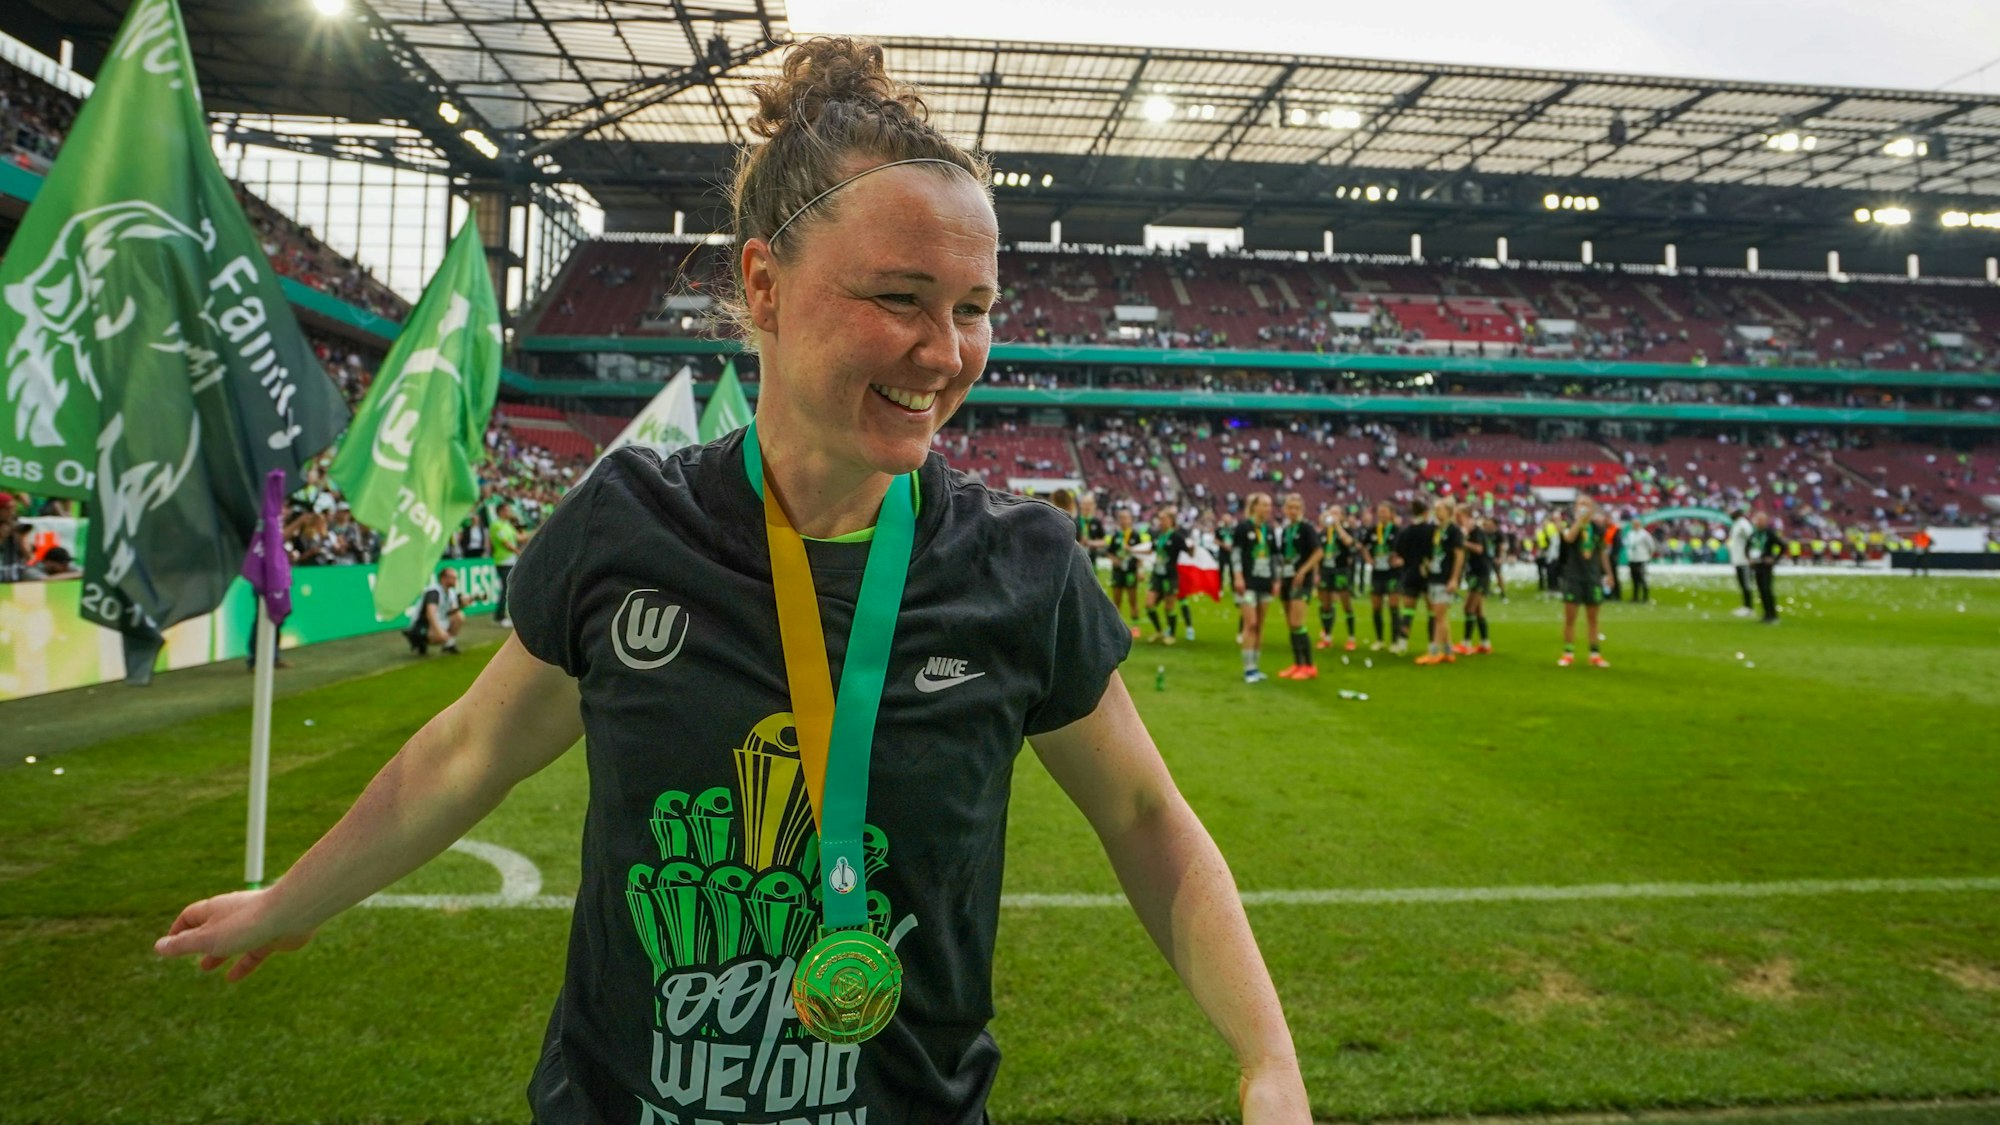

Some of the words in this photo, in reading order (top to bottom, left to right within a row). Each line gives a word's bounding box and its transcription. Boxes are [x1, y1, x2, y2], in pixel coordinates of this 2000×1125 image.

[0, 449, 43, 482] as
[925, 656, 968, 677] NIKE
[651, 1030, 751, 1112] WE
[765, 1041, 861, 1112] DID
